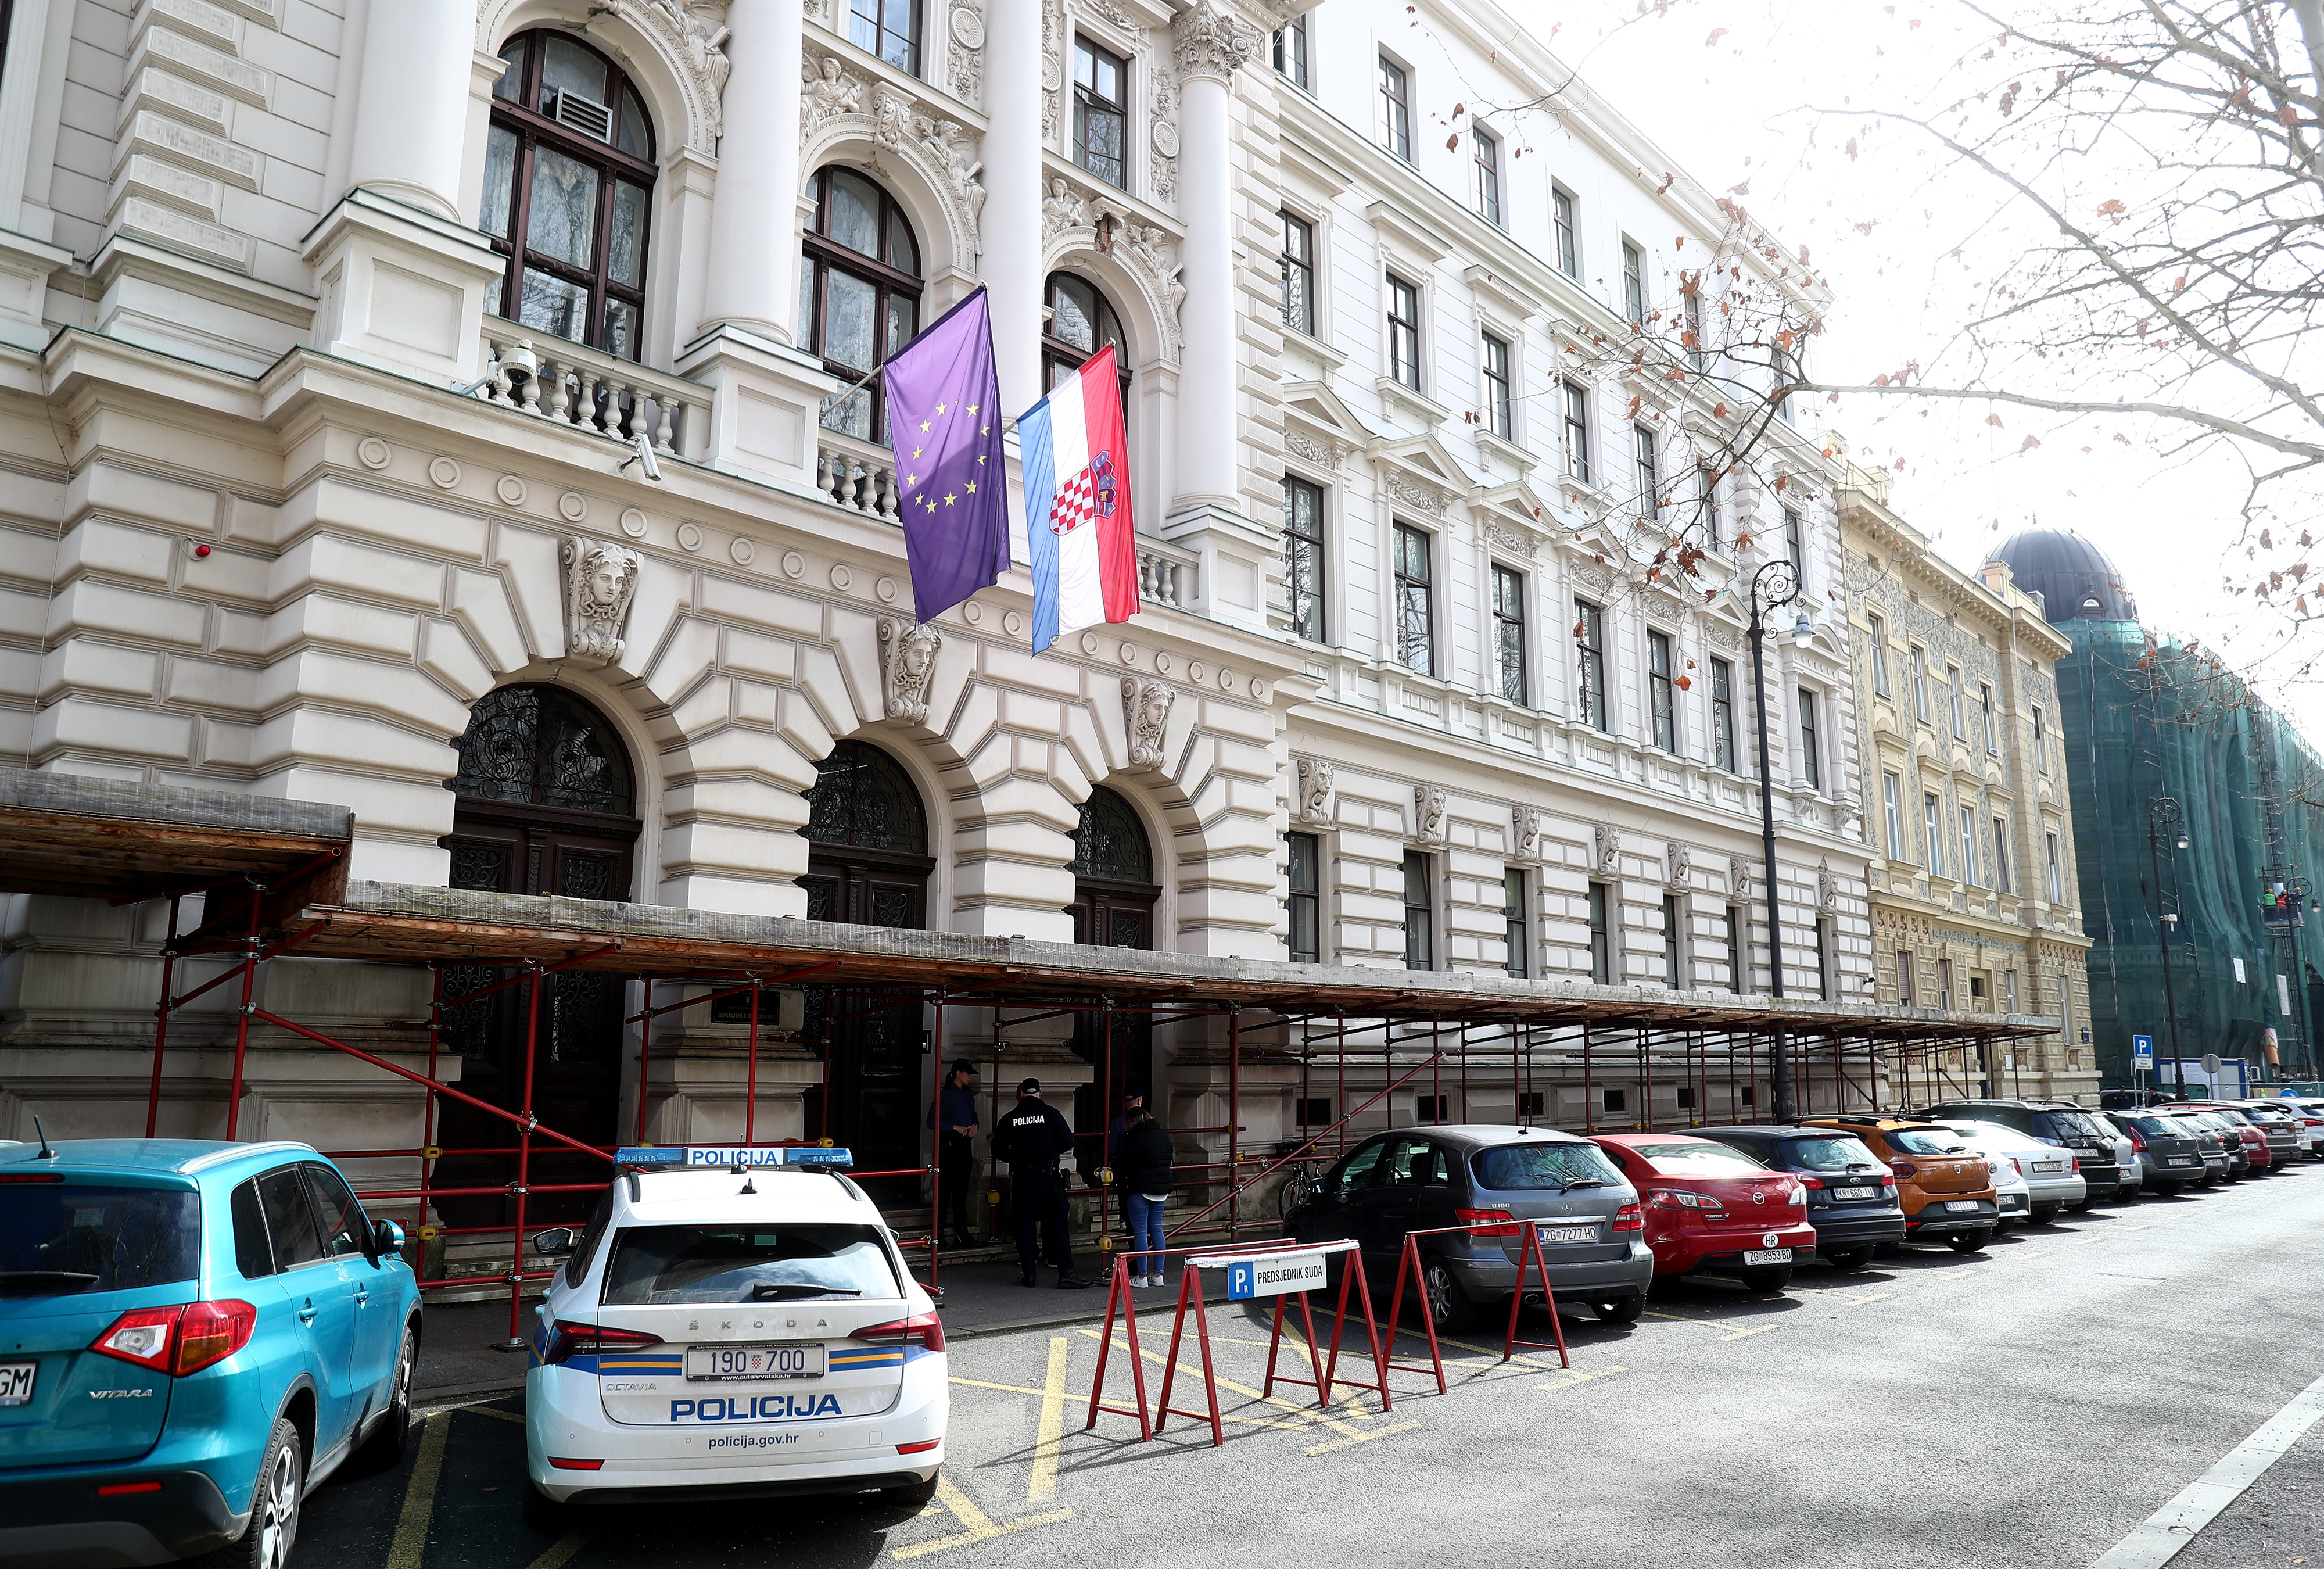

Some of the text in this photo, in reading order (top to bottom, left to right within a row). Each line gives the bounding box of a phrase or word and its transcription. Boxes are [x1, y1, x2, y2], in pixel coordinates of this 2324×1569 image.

[2139, 1040, 2147, 1053] P
[1013, 1115, 1045, 1126] POLICIJA
[693, 1151, 778, 1165] POLICIJA
[1838, 1188, 1848, 1198] KR
[1544, 1229, 1556, 1241] ZG
[1766, 1235, 1776, 1246] HR
[1749, 1251, 1759, 1262] ZG
[1257, 1265, 1322, 1284] PREDSJEDNIK SUDA
[689, 1318, 827, 1330] ŠKODA
[711, 1349, 804, 1373] 190 700
[605, 1383, 657, 1391] OCTAVIA
[89, 1389, 152, 1399] VITARA
[670, 1394, 843, 1423] POLICIJA
[708, 1433, 799, 1450] policija.gov.hr
